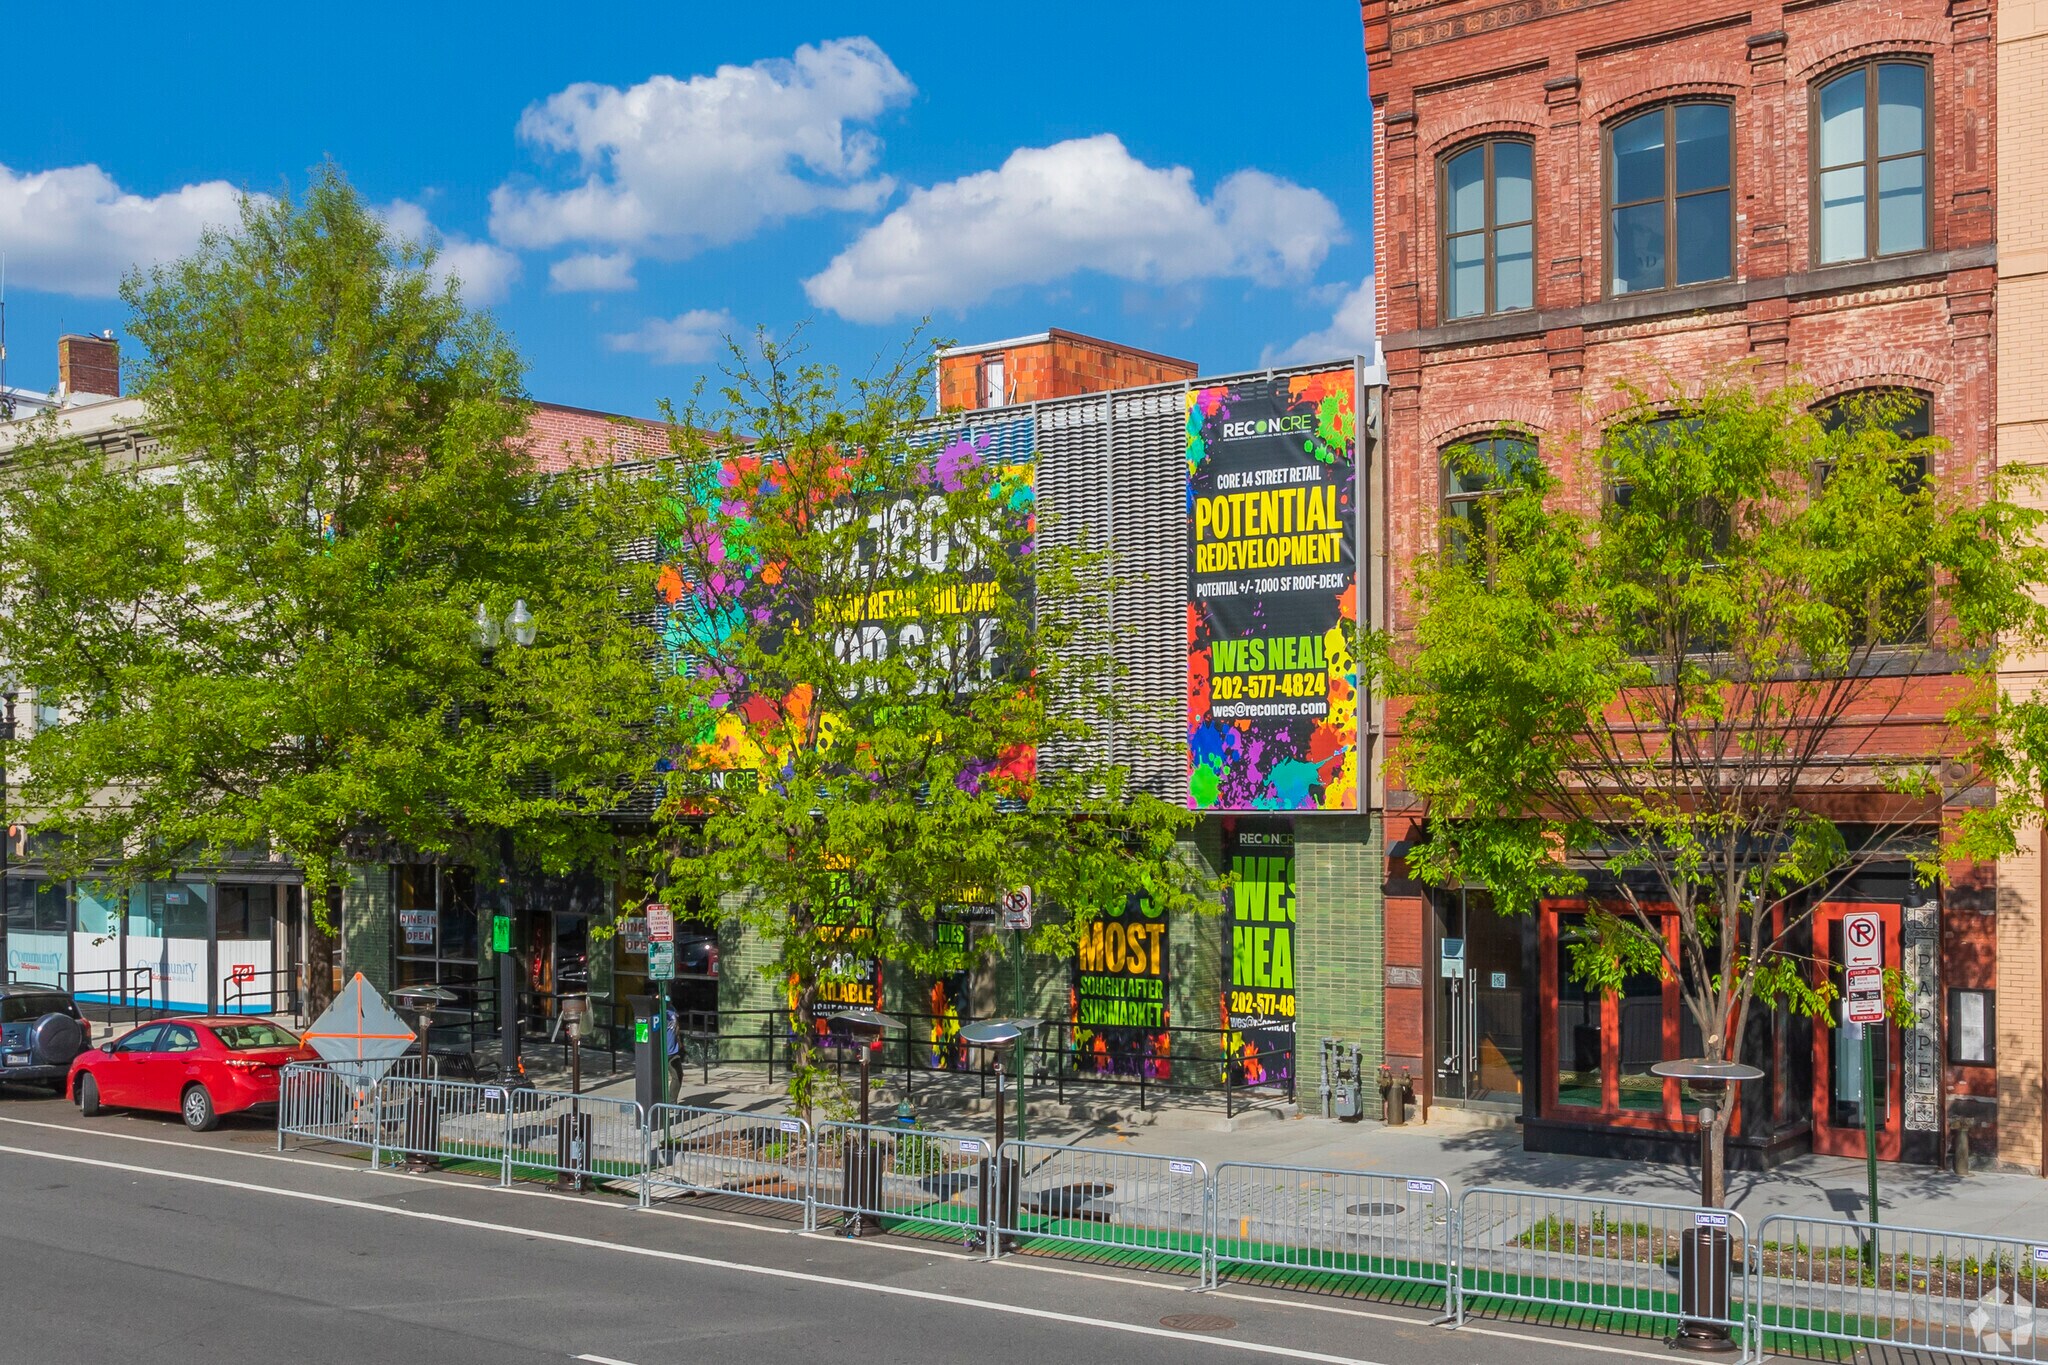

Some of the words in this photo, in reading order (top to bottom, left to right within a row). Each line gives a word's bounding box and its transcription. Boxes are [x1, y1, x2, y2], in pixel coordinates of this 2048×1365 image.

[1223, 414, 1312, 438] RECONCRE
[1217, 472, 1241, 490] CORE
[1242, 471, 1254, 487] 14
[1254, 468, 1289, 486] STREET
[1289, 465, 1321, 483] RETAIL
[1196, 484, 1343, 541] POTENTIAL
[1196, 532, 1343, 574] REDEVELOPMENT
[924, 581, 1000, 614] UILDING
[1196, 581, 1239, 597] POTENTIAL
[1255, 578, 1279, 595] 7,000
[1280, 577, 1292, 591] SF
[1293, 573, 1344, 591] ROOF-DECK
[1211, 637, 1265, 673] WES
[1269, 635, 1327, 671] NEAL
[1212, 672, 1326, 700] 202-577-4824
[1212, 701, 1327, 718] wes@reconcre.com
[401, 914, 437, 925] DINE-IN
[617, 921, 646, 934] DINE
[406, 931, 431, 941] OPEN
[626, 940, 647, 950] OPE
[1079, 921, 1165, 975] MOST
[1232, 926, 1295, 989] NEA
[818, 981, 874, 1004] AILABLE
[1080, 976, 1127, 997] SOUGHT
[1127, 978, 1163, 999] AFTER
[1080, 999, 1163, 1028] SUBMARKET
[1231, 990, 1296, 1017] 202-577-48
